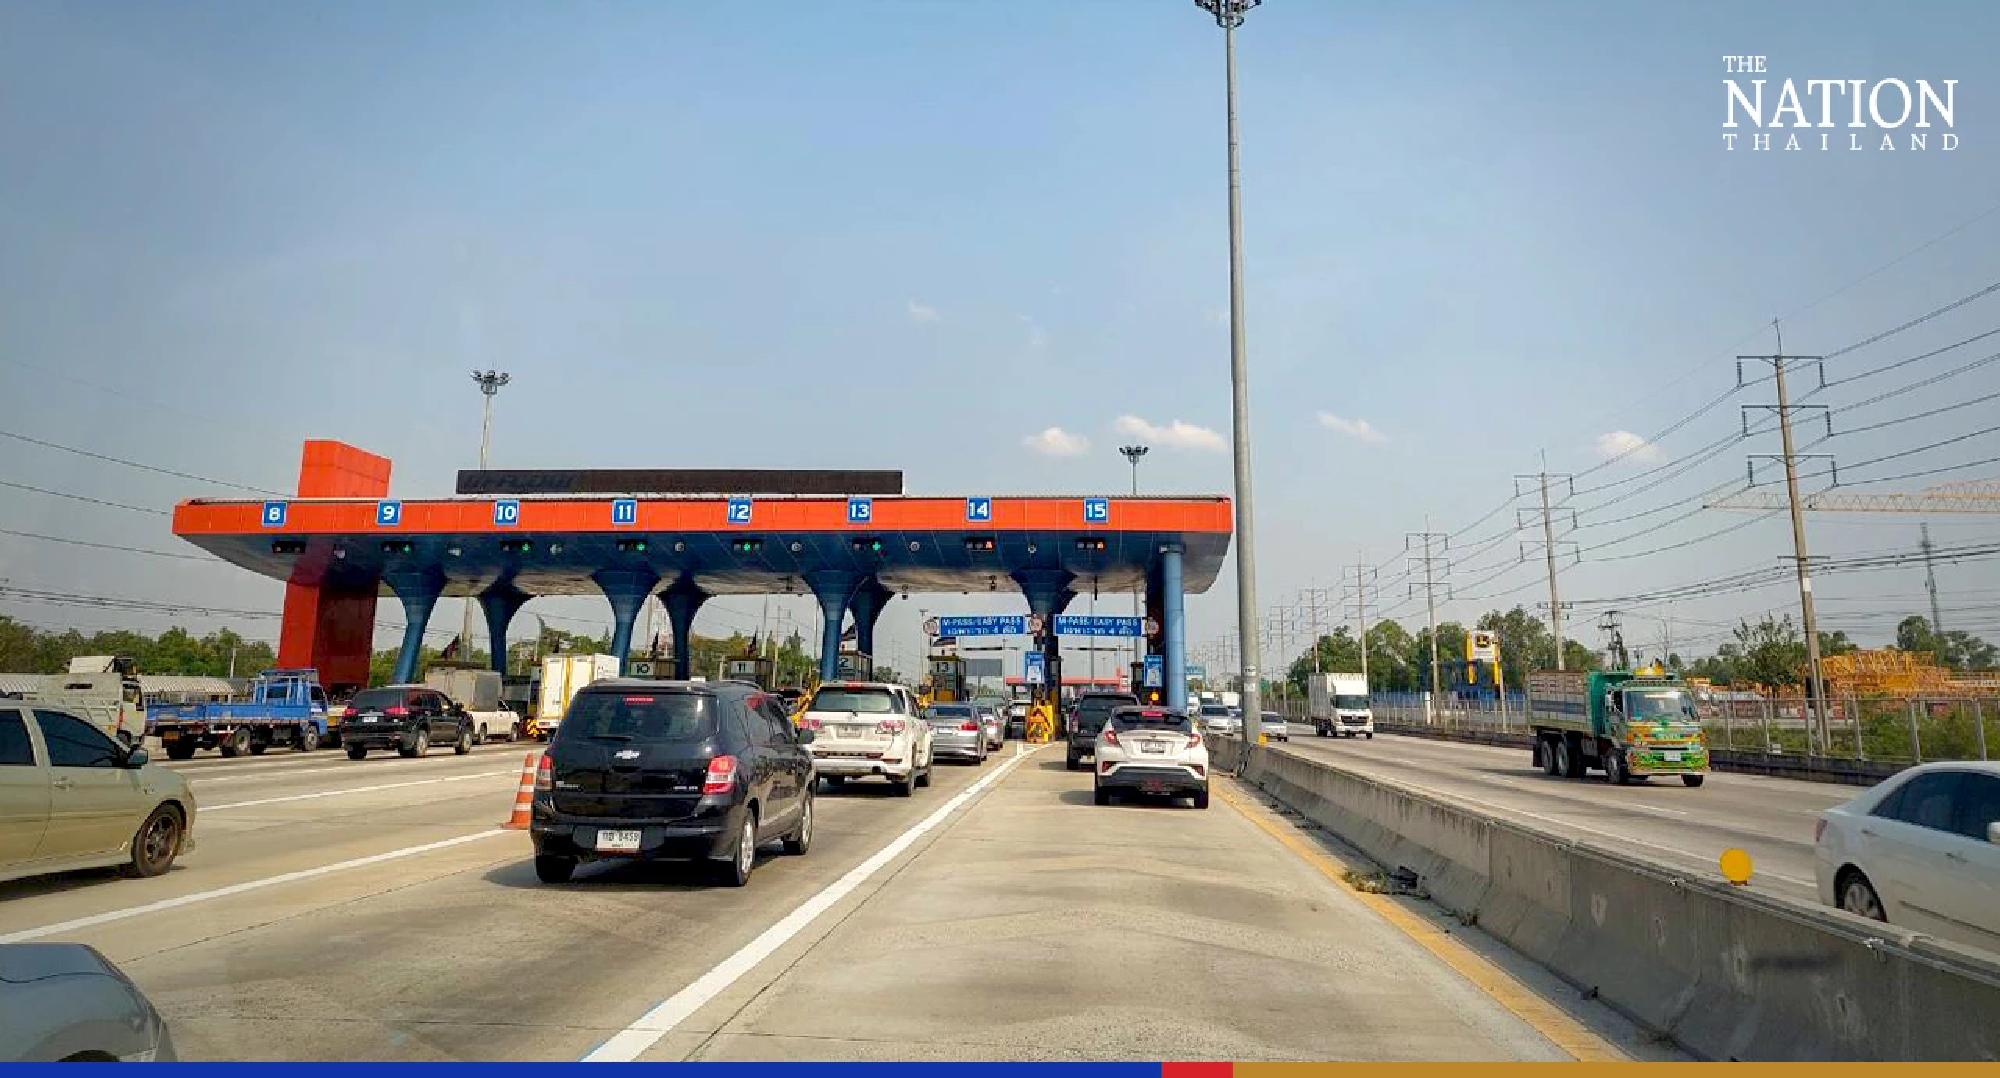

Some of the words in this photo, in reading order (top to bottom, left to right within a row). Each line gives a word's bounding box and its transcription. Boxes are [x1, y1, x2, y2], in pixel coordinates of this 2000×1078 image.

[269, 506, 281, 521] 8
[383, 506, 395, 520] 9
[497, 505, 516, 520] 10
[618, 504, 632, 519] 11
[730, 504, 748, 519] 12
[851, 504, 869, 518] 13
[969, 502, 987, 517] 14
[1087, 503, 1105, 518] 15
